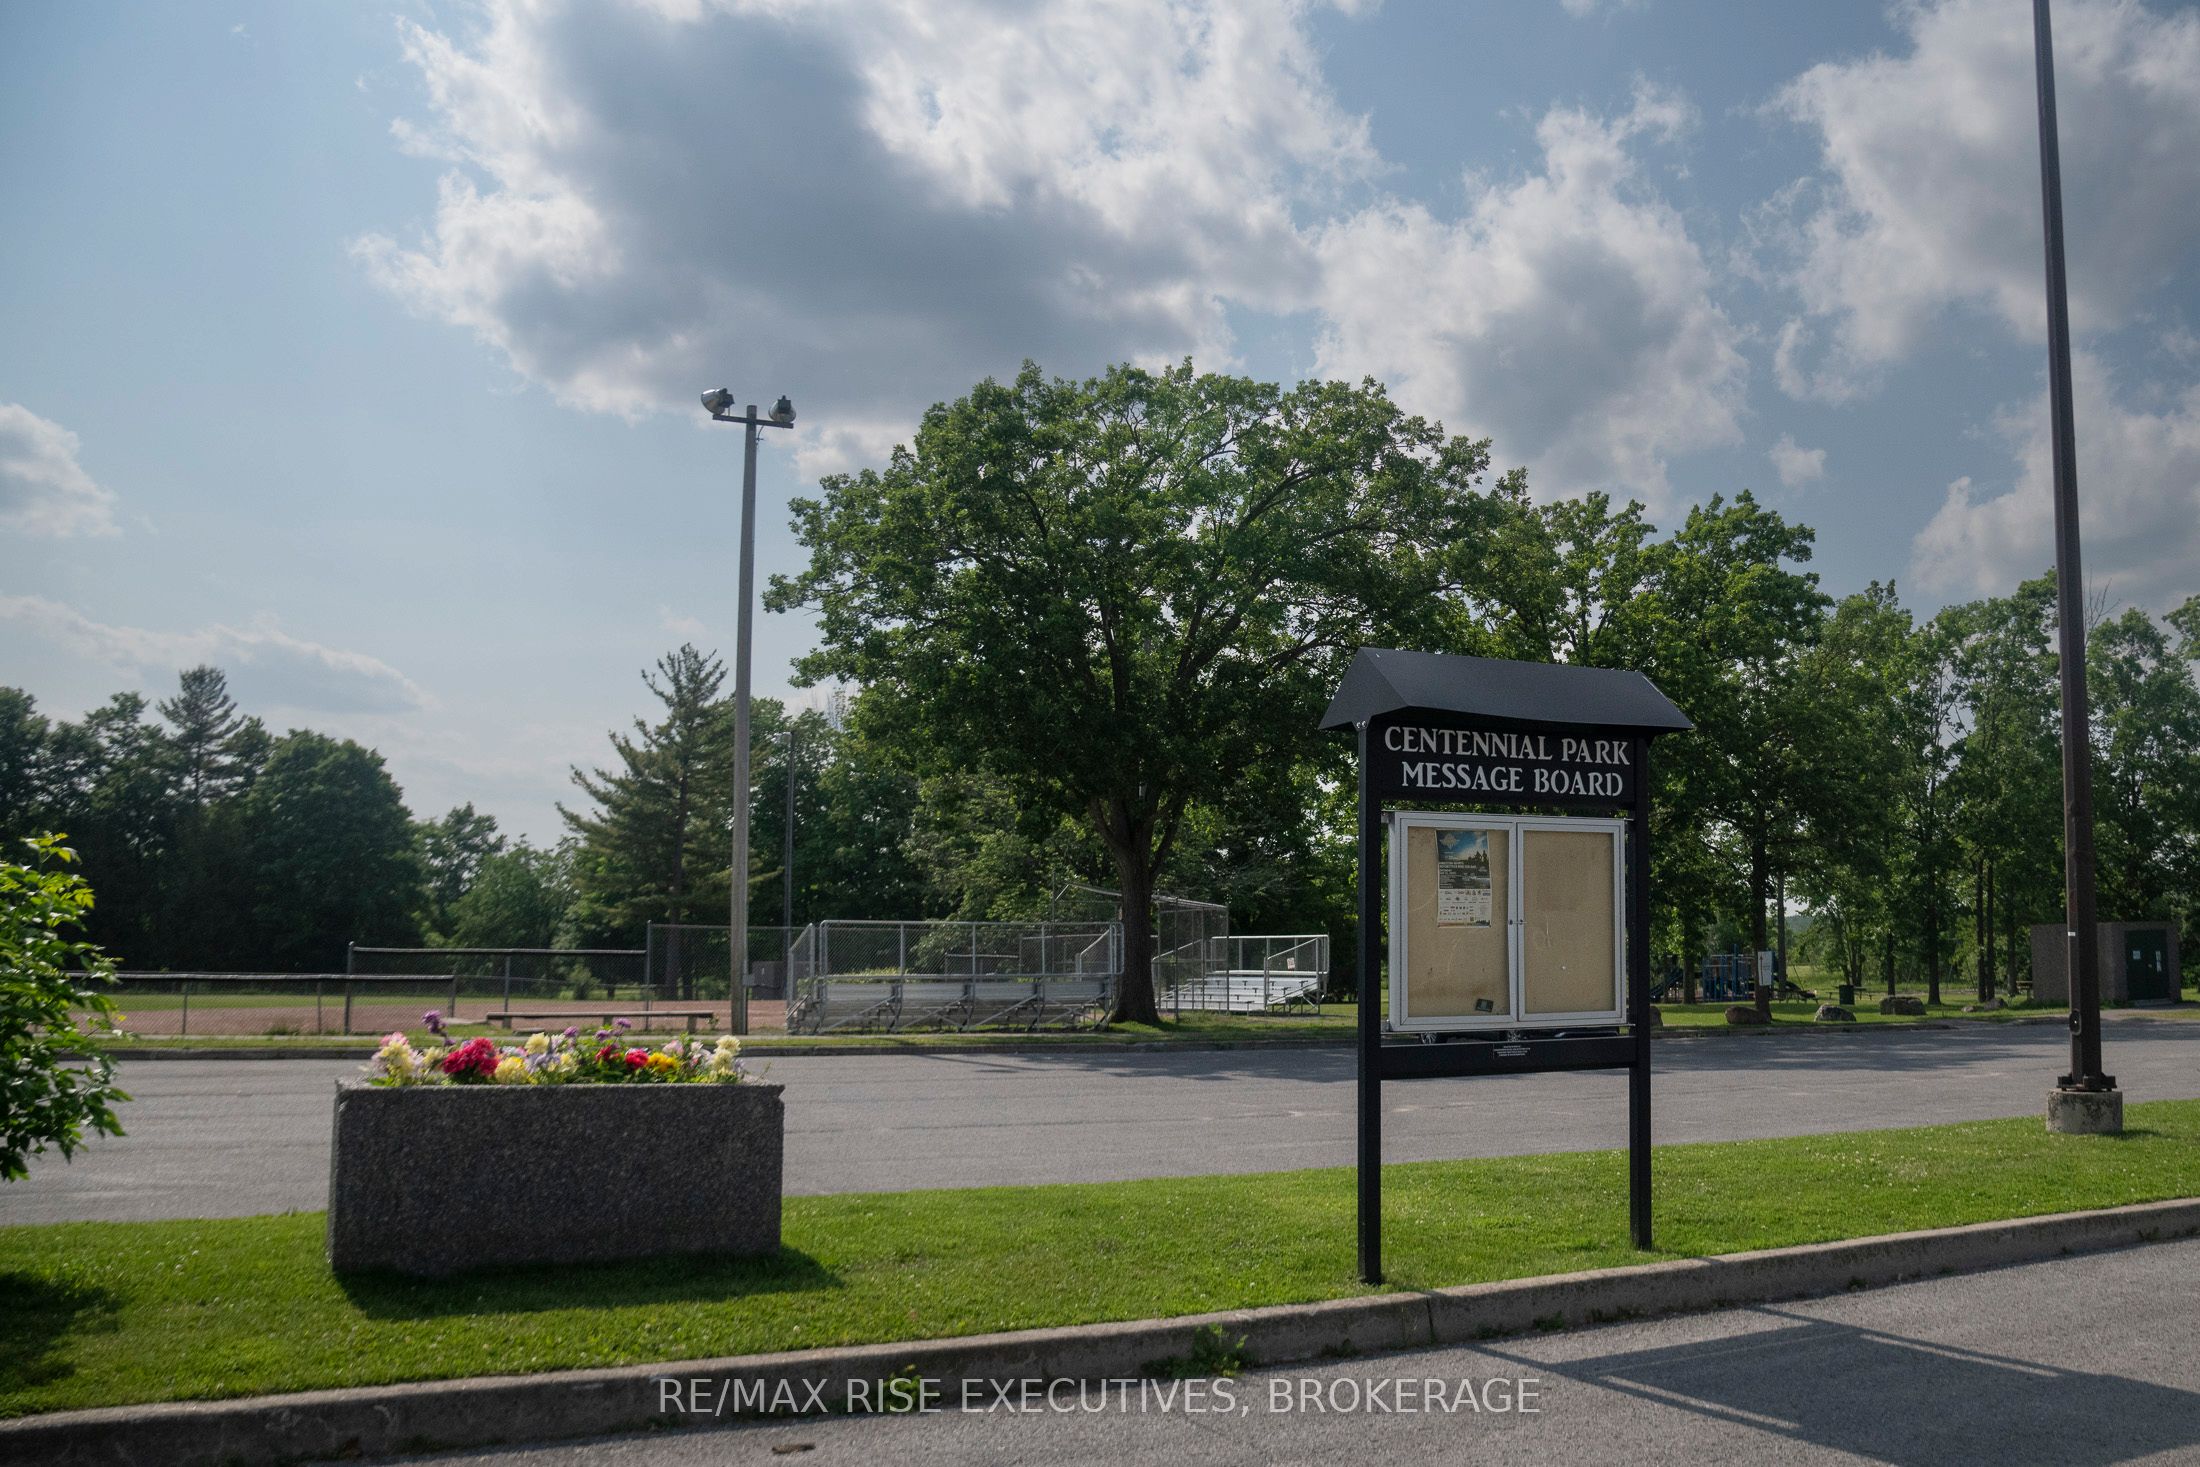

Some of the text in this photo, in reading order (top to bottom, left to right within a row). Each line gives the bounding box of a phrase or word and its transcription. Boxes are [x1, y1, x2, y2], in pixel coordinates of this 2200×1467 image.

[1384, 726, 1631, 765] CENTENNIAL PARK
[1401, 761, 1623, 797] MESSAGE BOARD
